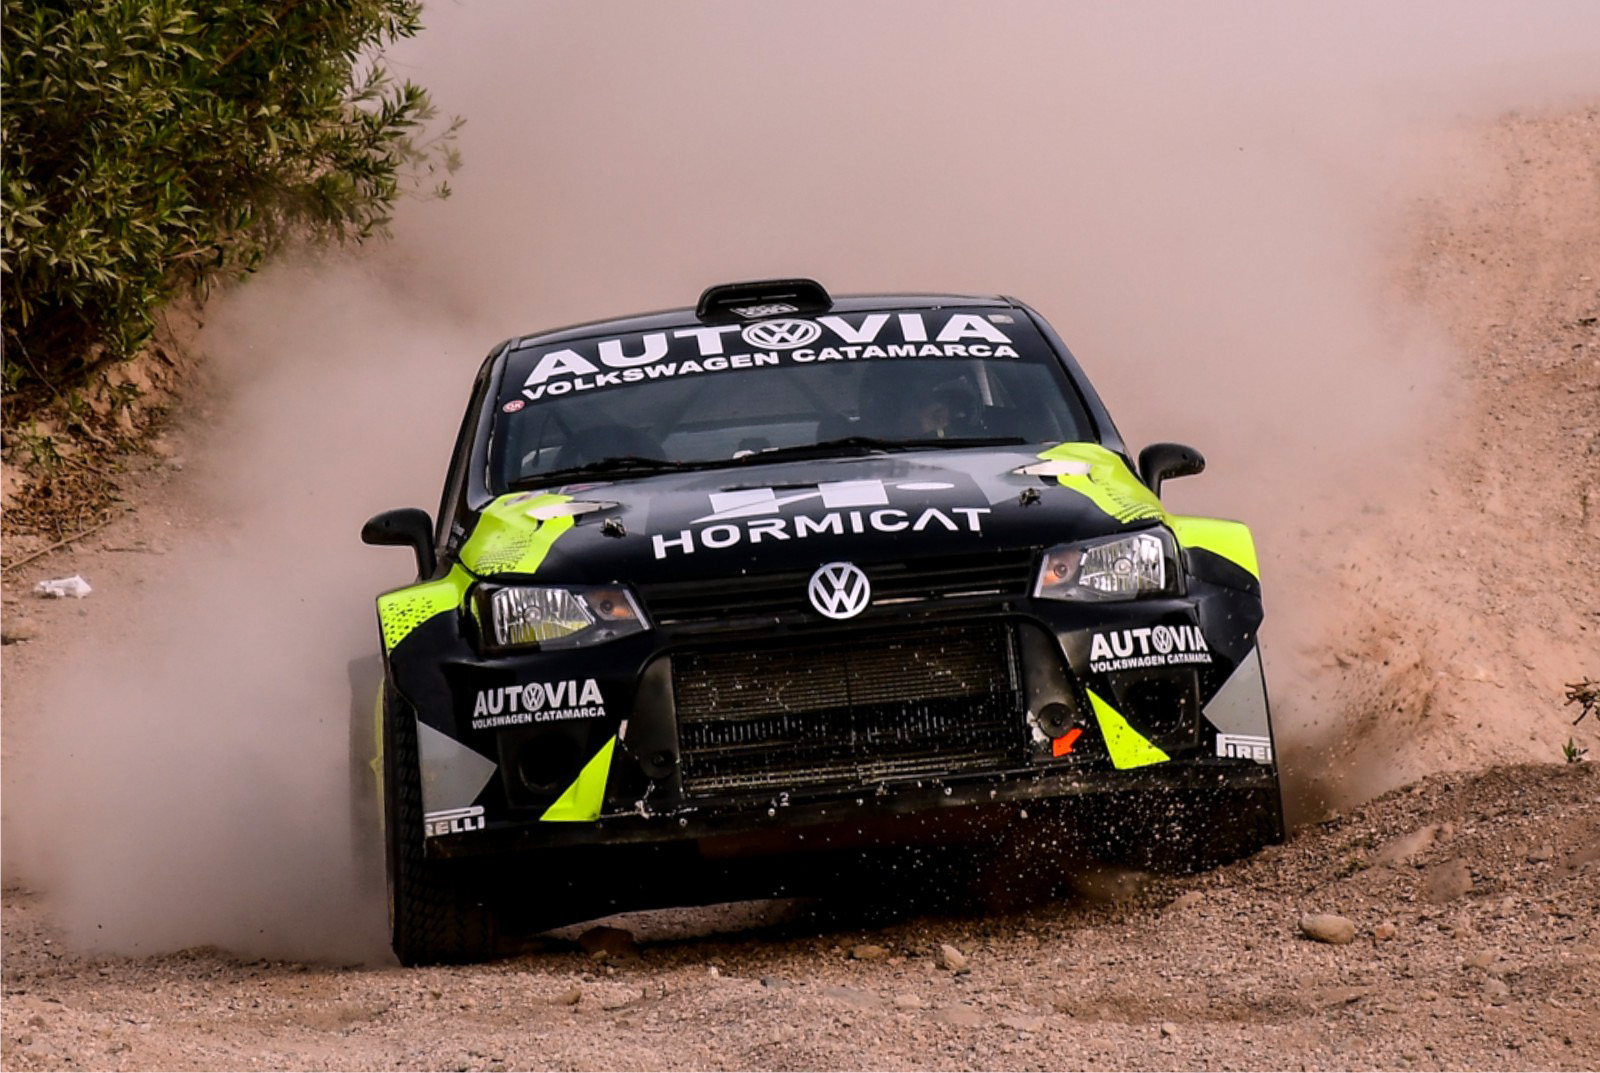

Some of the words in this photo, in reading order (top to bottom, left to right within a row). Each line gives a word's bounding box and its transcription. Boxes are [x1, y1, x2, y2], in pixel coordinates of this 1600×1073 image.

[521, 351, 780, 401] VOLKSWAGEN
[792, 344, 1021, 364] CATAMARCA
[652, 508, 992, 560] HORMICAT
[1089, 625, 1209, 662] AUTOVIA
[1089, 655, 1166, 674] VOLKSWAGEN
[473, 678, 605, 718] AUTOVIA
[472, 712, 532, 730] VOLKSWAGEN
[534, 706, 606, 722] CATAMARCA
[1216, 733, 1272, 761] PIRE
[424, 805, 485, 837] RELLI
